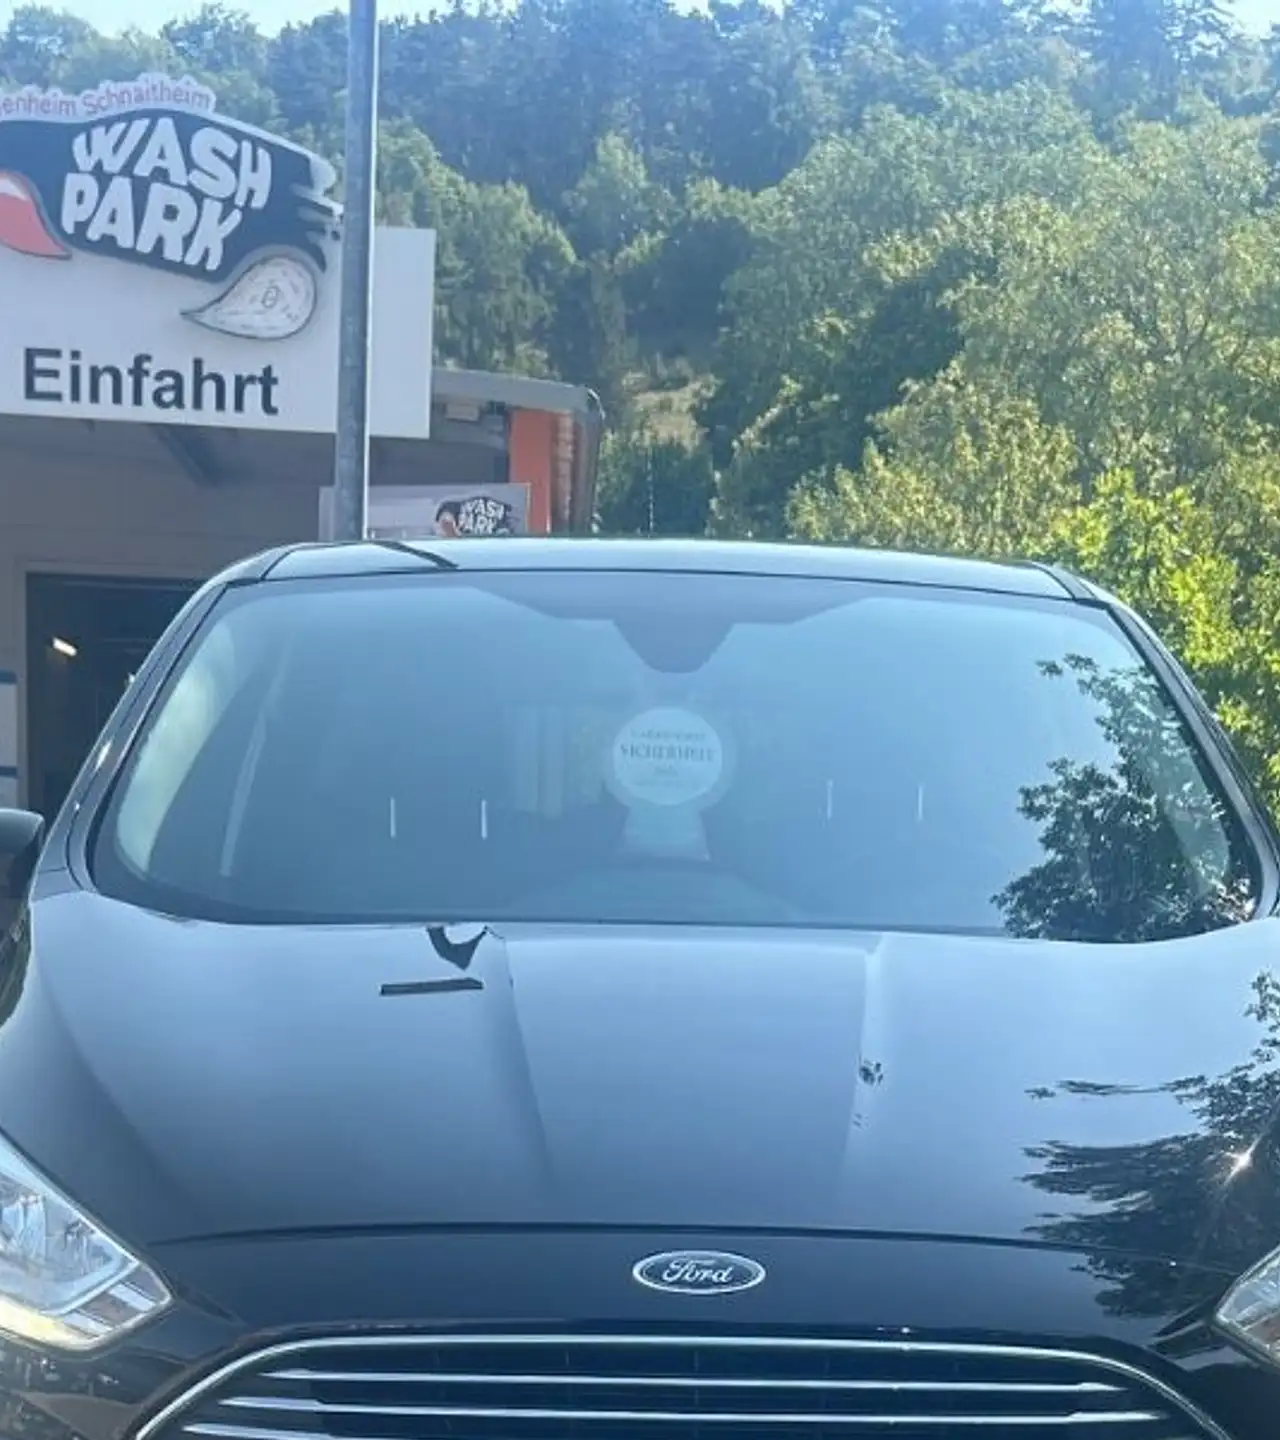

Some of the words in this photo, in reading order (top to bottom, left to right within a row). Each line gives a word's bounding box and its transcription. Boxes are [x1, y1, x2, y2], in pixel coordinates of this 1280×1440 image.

[82, 79, 212, 116] Schnaitheim
[72, 116, 272, 211] WASH
[61, 172, 243, 272] PARK
[24, 346, 280, 416] Einfahrt
[461, 498, 505, 521] WASH
[662, 1258, 734, 1284] Ford
